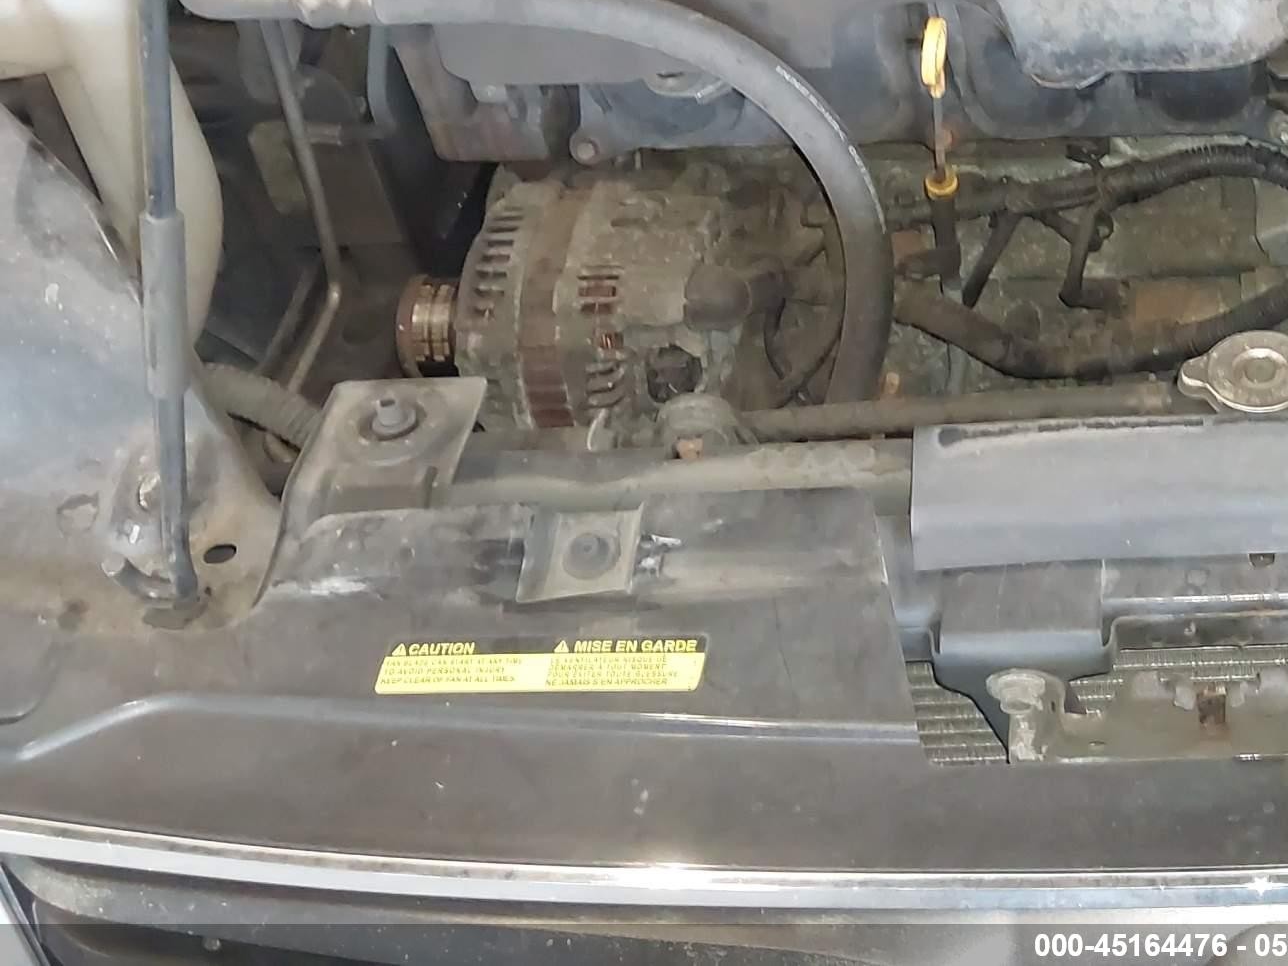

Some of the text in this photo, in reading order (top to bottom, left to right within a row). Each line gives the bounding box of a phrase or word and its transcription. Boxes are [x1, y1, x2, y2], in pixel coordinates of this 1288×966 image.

[408, 642, 476, 655] CAUTION
[574, 639, 698, 653] MISE EN GARDE
